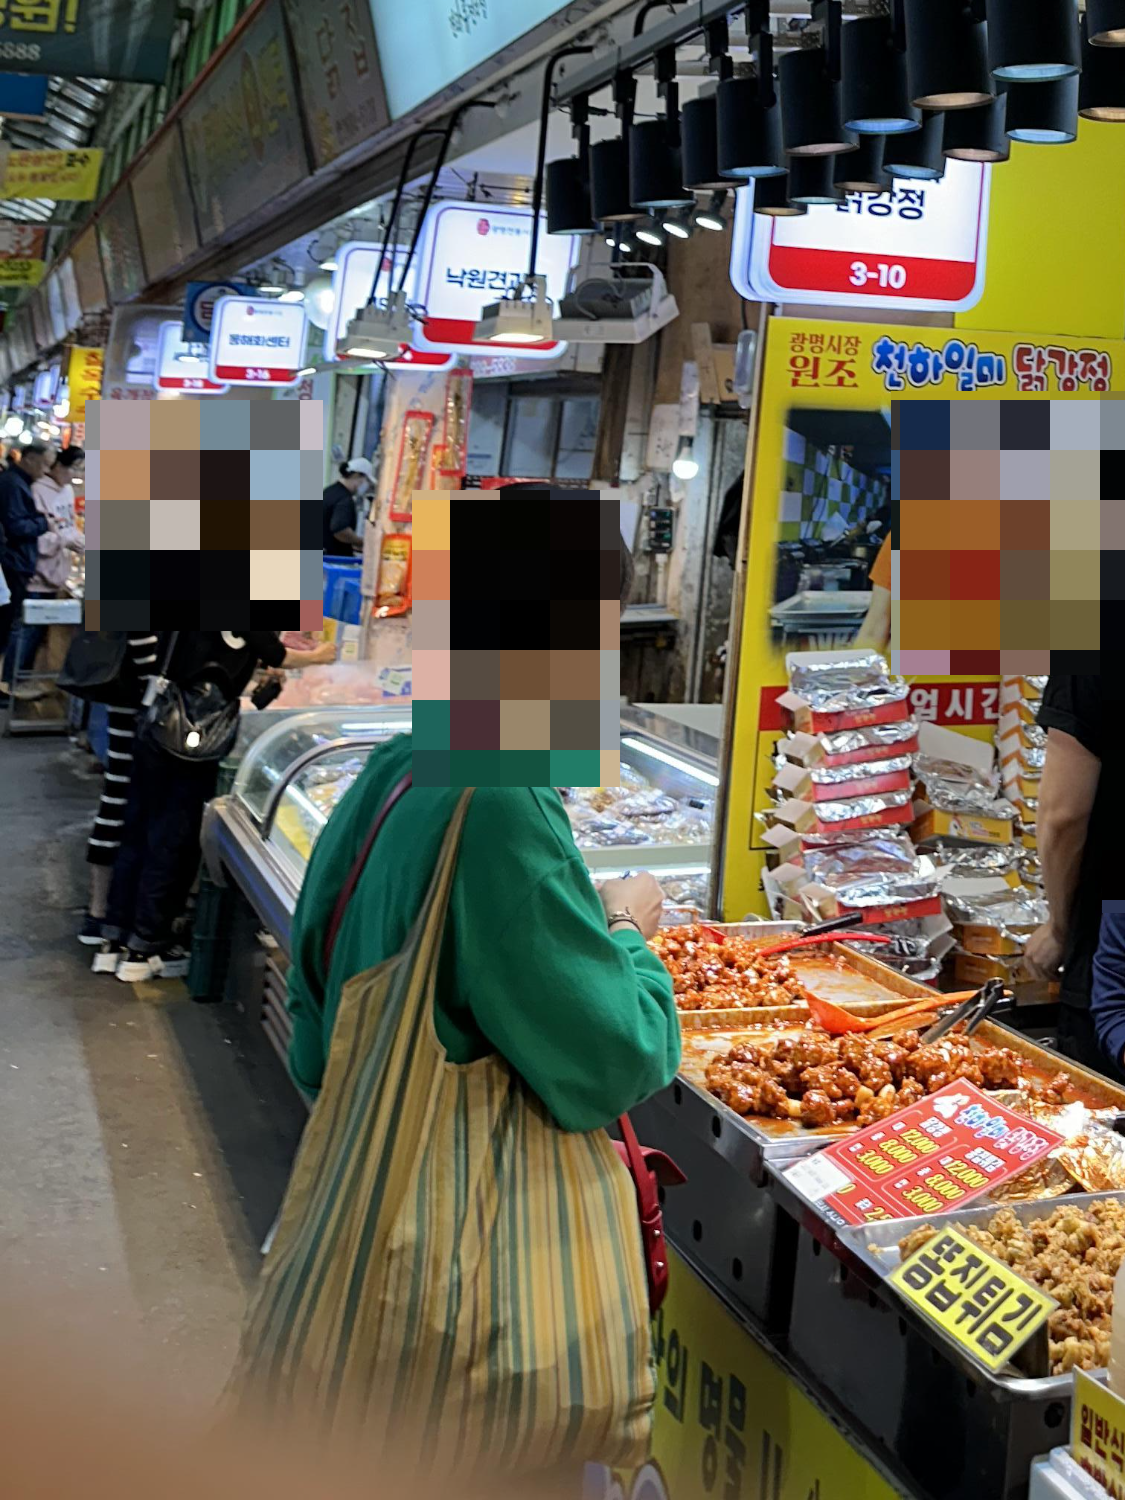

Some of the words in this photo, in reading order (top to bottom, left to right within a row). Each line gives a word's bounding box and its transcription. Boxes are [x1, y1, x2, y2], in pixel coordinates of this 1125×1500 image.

[849, 261, 906, 290] 3-10
[788, 333, 861, 356] 광명시장
[787, 357, 859, 388] 원조
[871, 335, 1006, 391] 천하일미
[1012, 342, 1112, 391] 닭강정
[909, 687, 1000, 721] 업시간
[879, 1138, 918, 1165] 8,000
[899, 1129, 941, 1155] 12,000
[855, 1149, 895, 1176] 3,000
[944, 1159, 989, 1188] 12,000
[902, 1186, 944, 1214] 3,000
[924, 1173, 966, 1201] 8,000
[902, 1235, 1043, 1356] 똥집튀김
